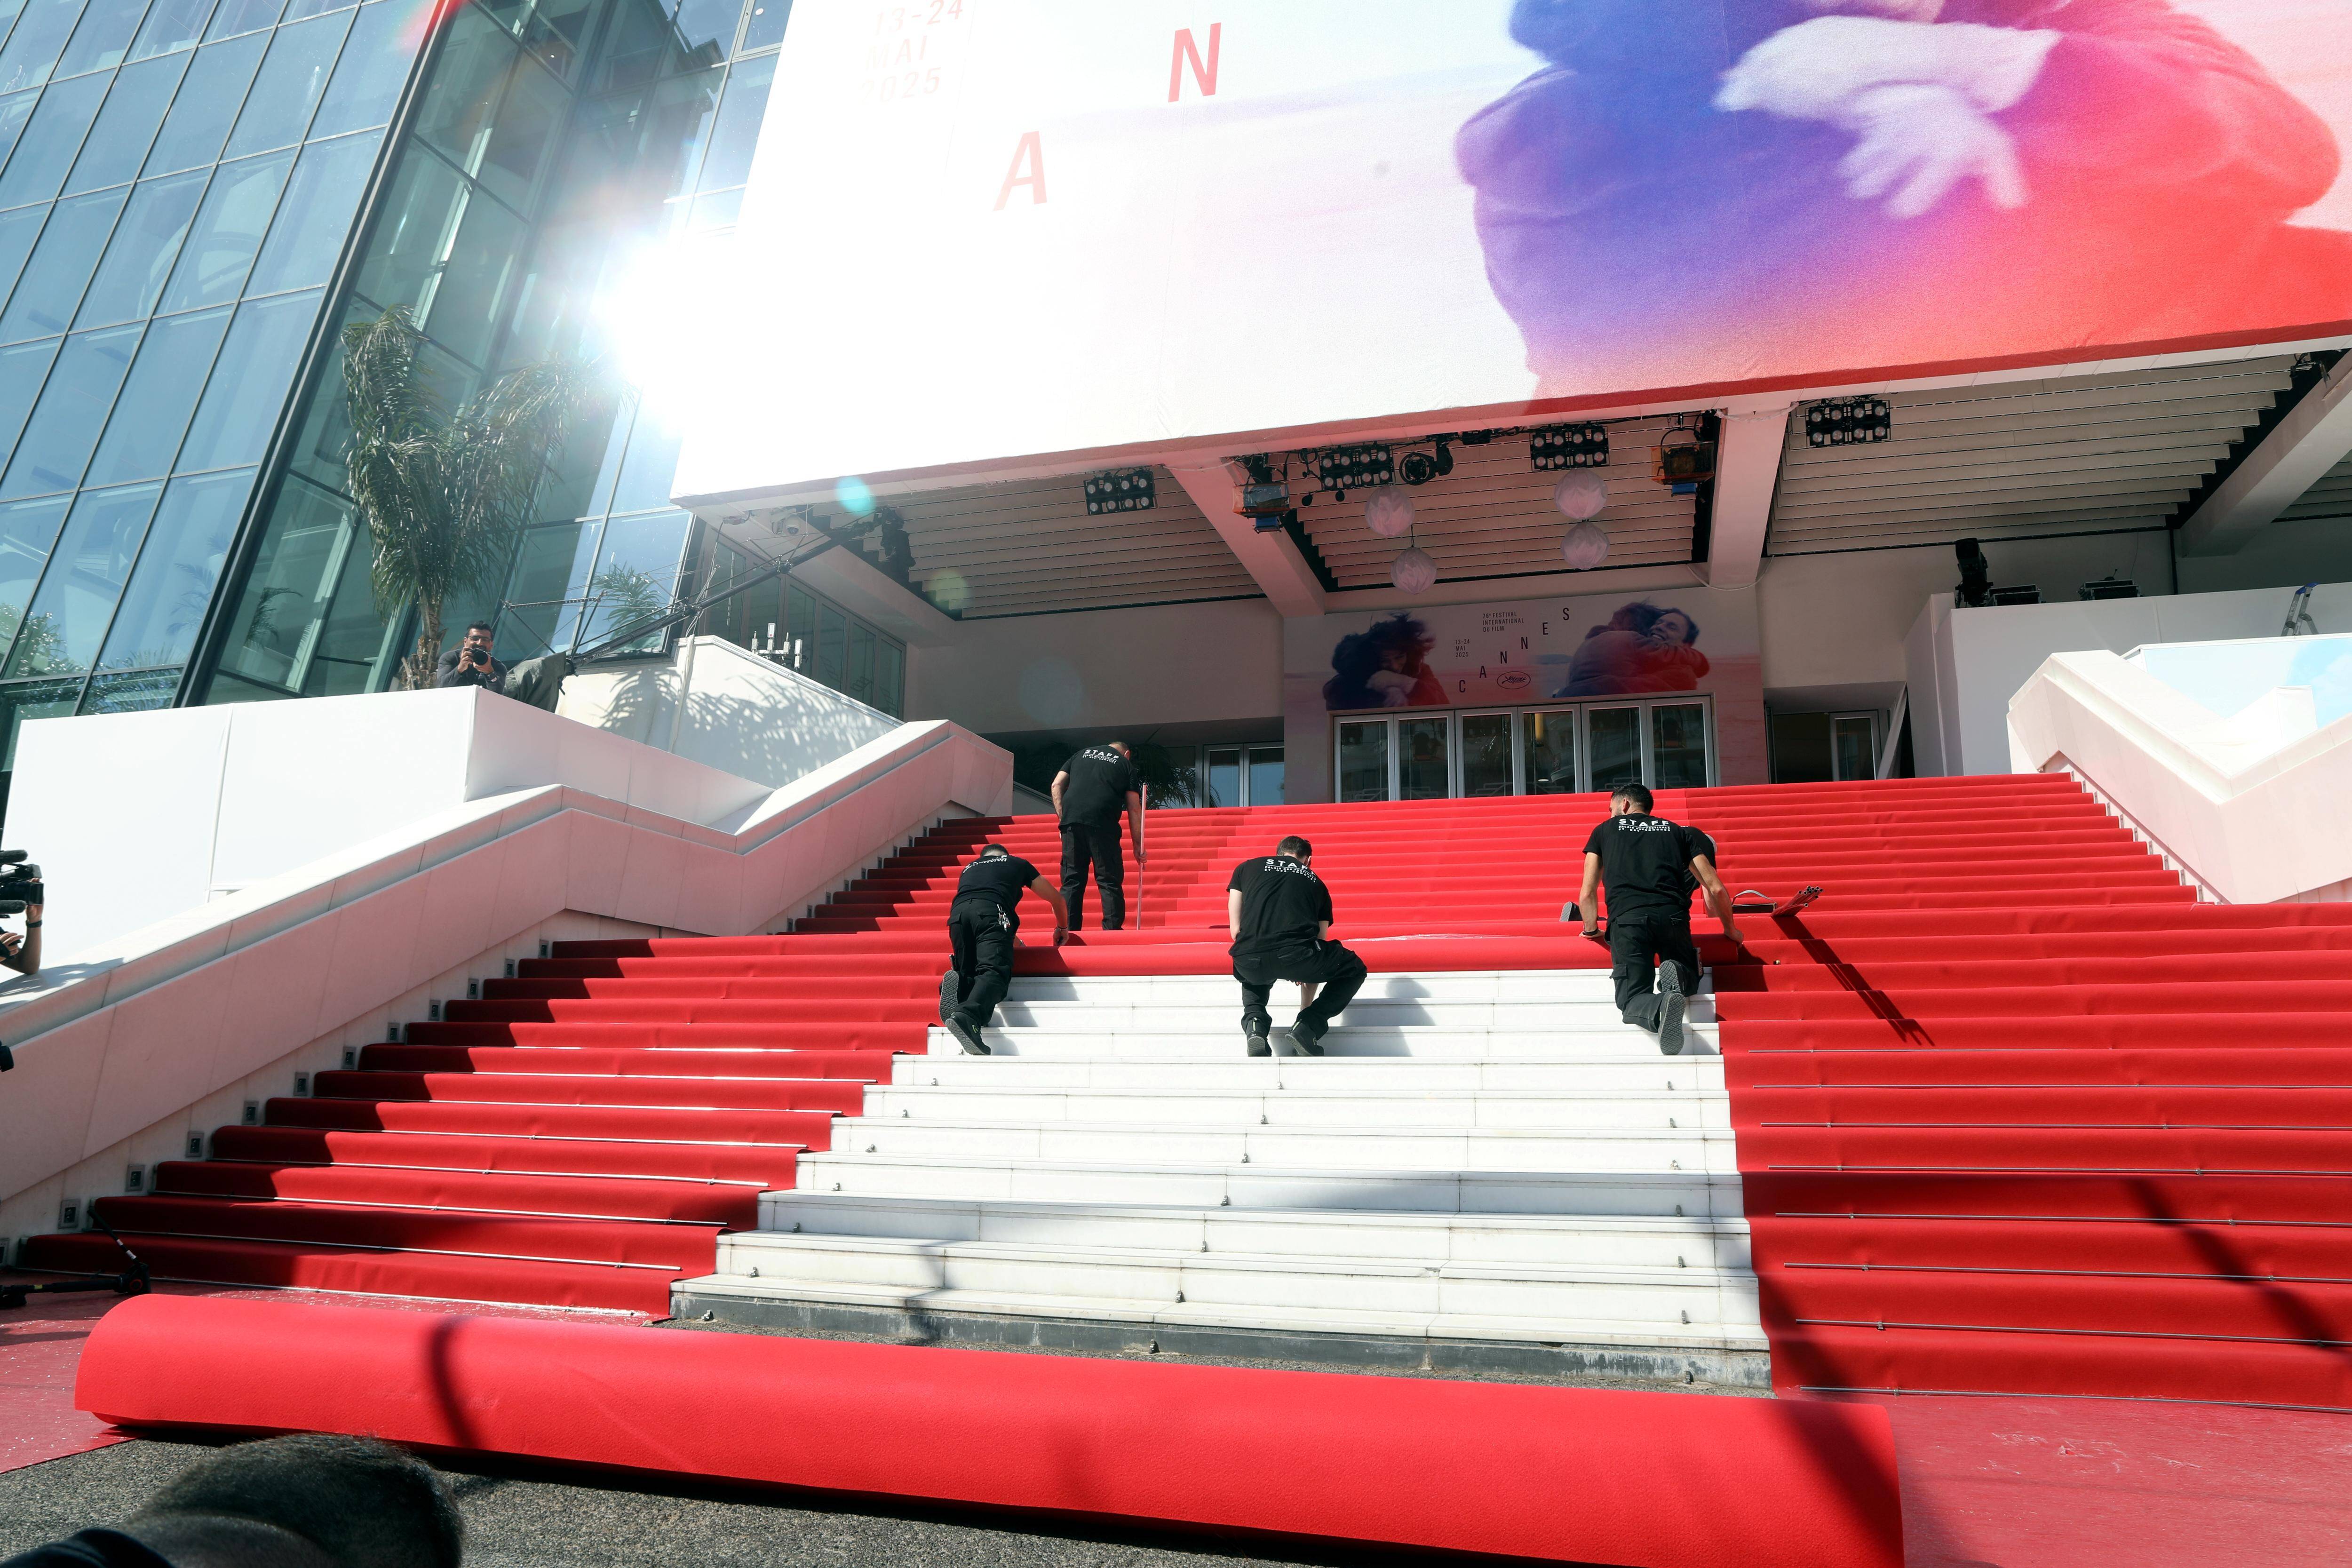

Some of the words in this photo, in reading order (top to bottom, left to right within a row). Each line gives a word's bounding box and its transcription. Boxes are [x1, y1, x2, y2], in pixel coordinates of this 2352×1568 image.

[874, 0, 963, 36] 13-24
[865, 35, 928, 72] MAI
[860, 67, 941, 103] 2025
[1084, 749, 1120, 759] STAFF
[1619, 819, 1669, 827] STAFF
